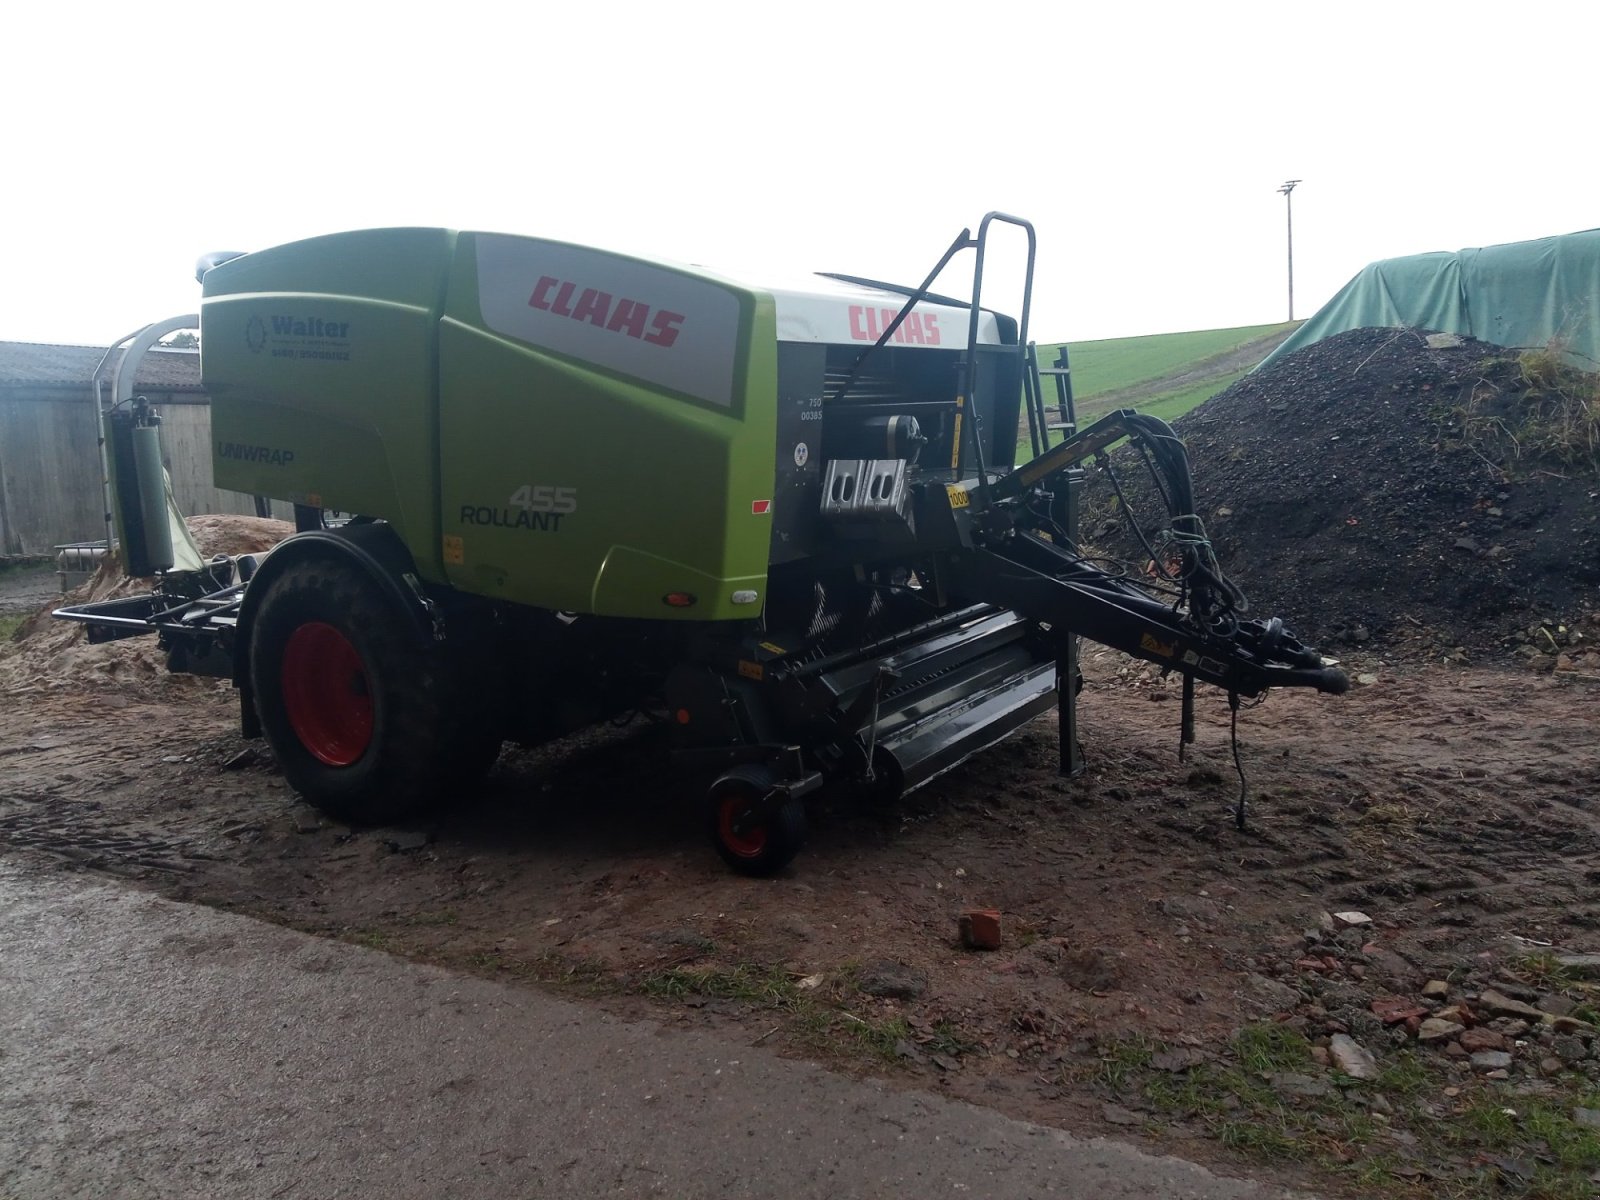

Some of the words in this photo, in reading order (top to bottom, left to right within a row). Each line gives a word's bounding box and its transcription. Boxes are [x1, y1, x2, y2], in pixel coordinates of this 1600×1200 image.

[529, 275, 685, 346] CLAAS
[272, 315, 349, 337] Walter
[848, 304, 941, 345] CLAAS
[808, 398, 822, 407] 750
[219, 443, 294, 467] UNIWRAP
[509, 484, 577, 513] 455
[949, 493, 968, 506] 1000
[460, 505, 565, 531] ROLLANT
